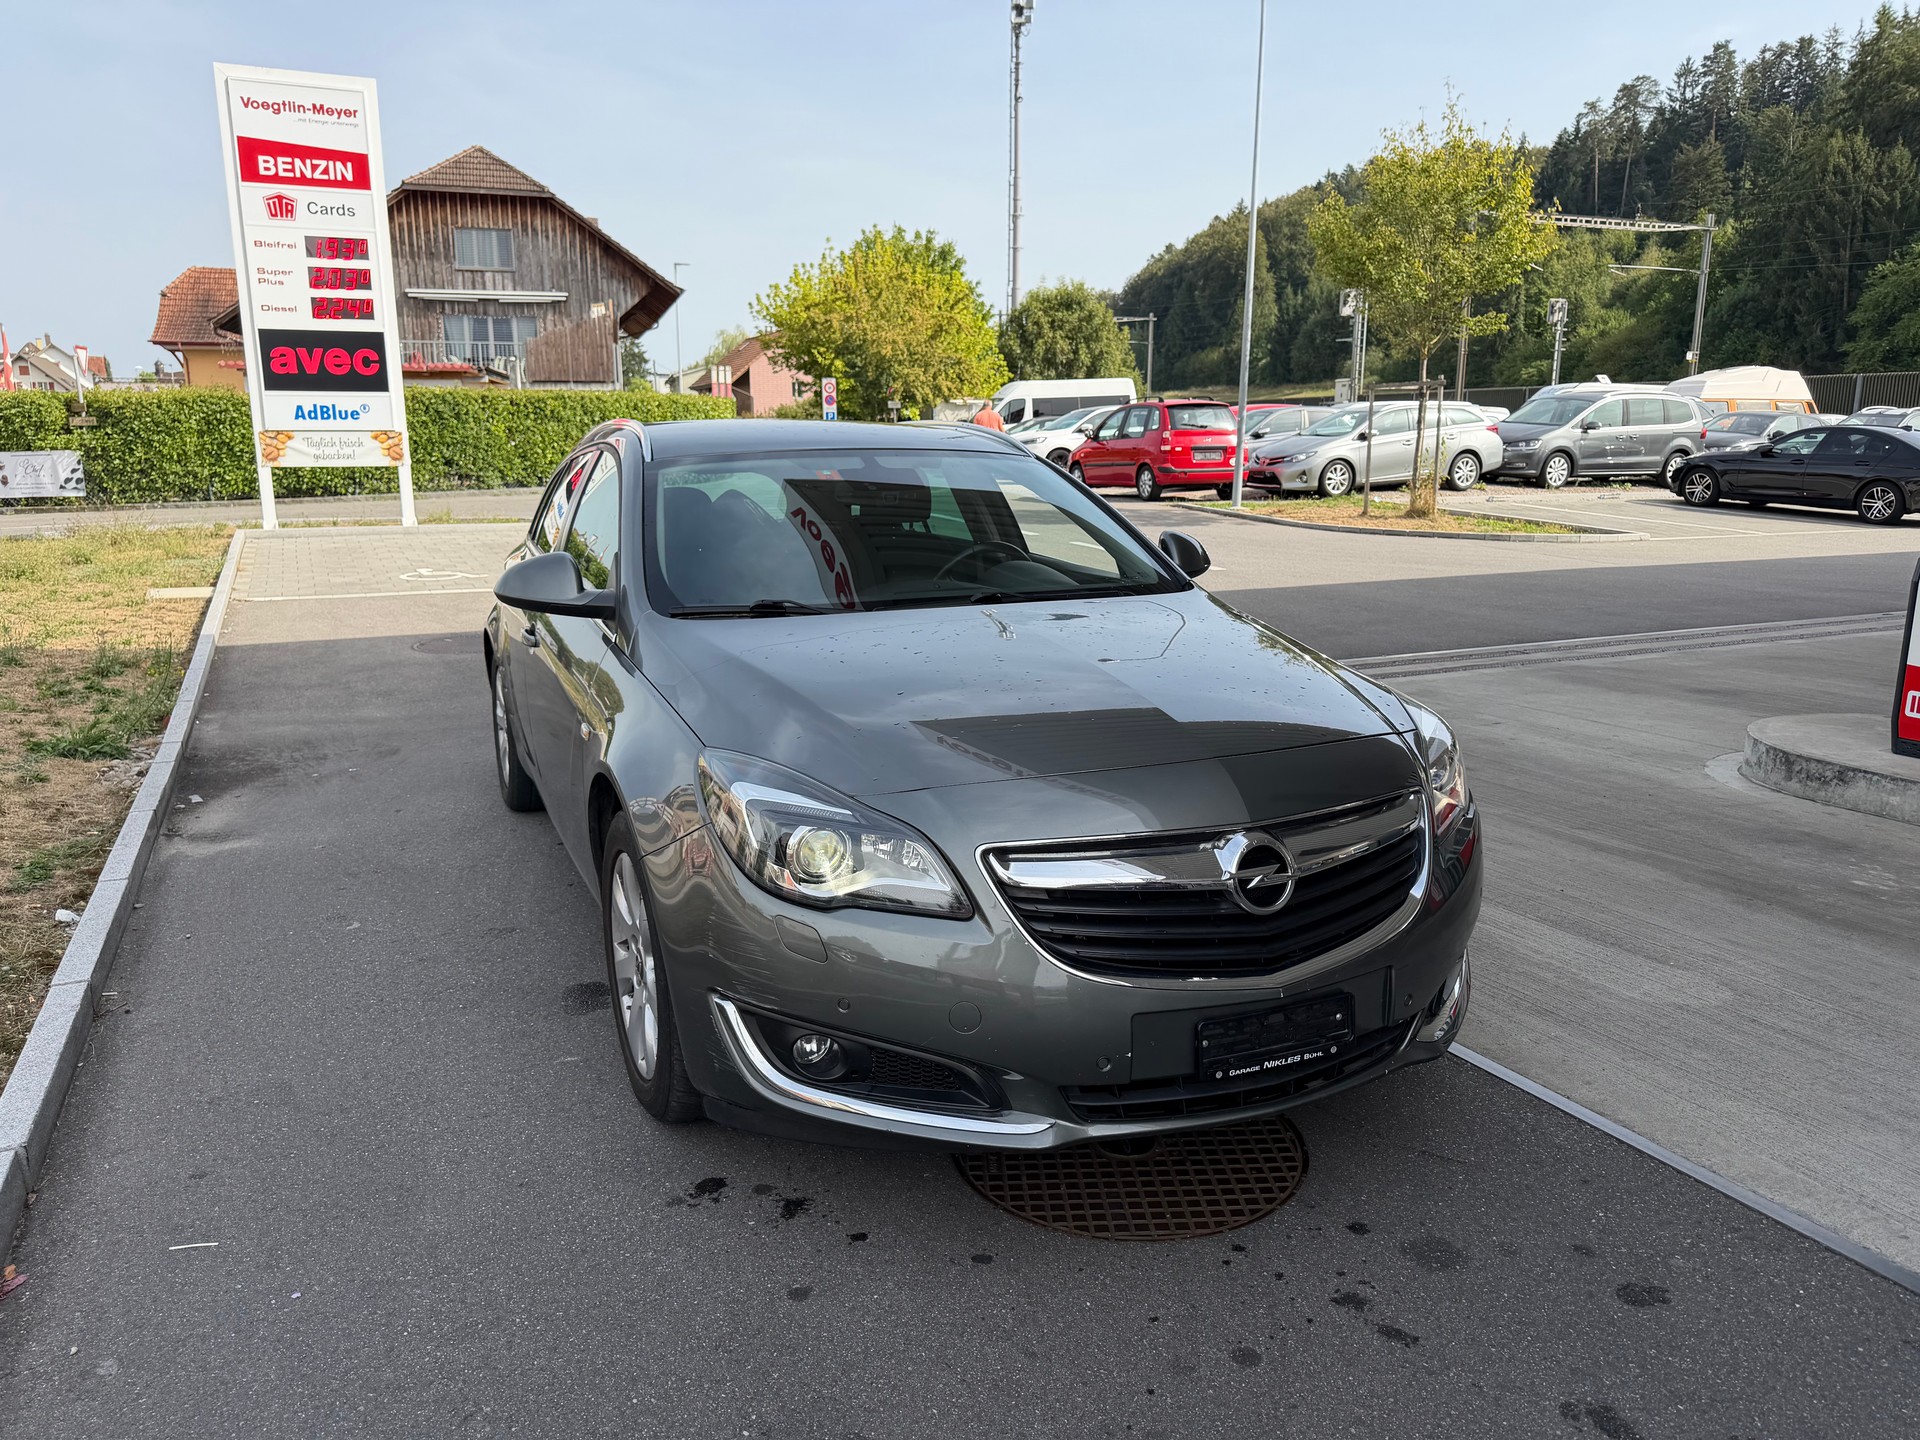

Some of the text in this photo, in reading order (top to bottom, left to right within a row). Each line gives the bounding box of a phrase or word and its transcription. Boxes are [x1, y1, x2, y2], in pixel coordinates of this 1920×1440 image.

[239, 96, 359, 119] Voegtlin-Meyer
[257, 154, 354, 182] BENZIN
[307, 201, 356, 217] Cards
[253, 239, 297, 250] Bleifrei
[256, 267, 294, 277] Super
[258, 277, 285, 286] Plus
[260, 304, 298, 313] Diesel
[269, 345, 381, 376] avec
[338, 436, 365, 450] frisch
[312, 449, 356, 463] gebacken!
[1263, 1054, 1302, 1069] NIKLES
